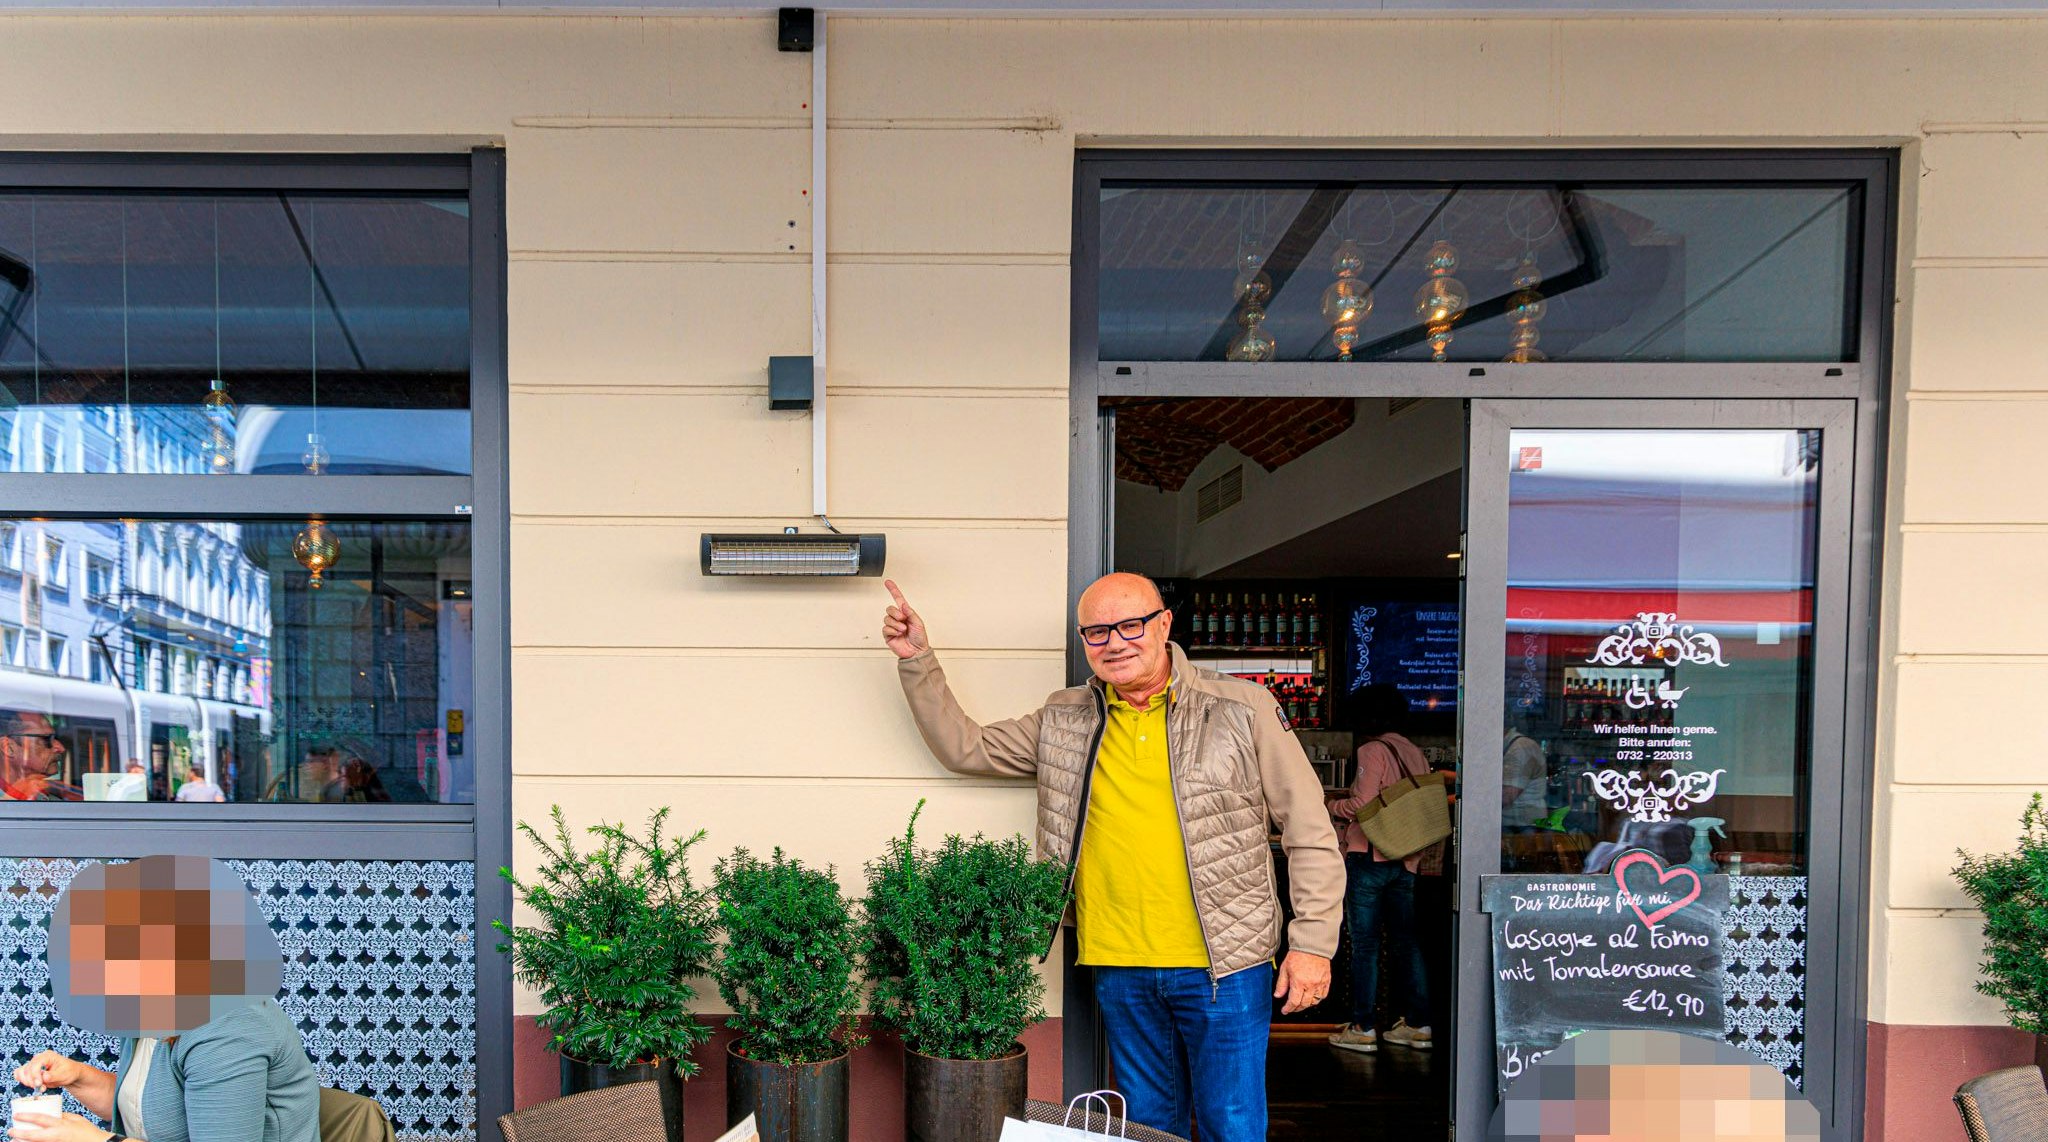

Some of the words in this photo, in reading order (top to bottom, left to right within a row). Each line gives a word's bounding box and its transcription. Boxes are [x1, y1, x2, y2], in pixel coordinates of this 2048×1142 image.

[1593, 724, 1613, 735] Wir
[1614, 724, 1647, 735] helfen
[1650, 724, 1680, 735] Ihnen
[1683, 726, 1717, 736] gerne.
[1619, 737, 1644, 747] Bitte
[1647, 737, 1691, 747] anrufen:
[1617, 750, 1643, 760] 0732
[1653, 750, 1693, 760] 220313
[1527, 883, 1597, 892] GASTRONOMIE
[1511, 895, 1543, 912] Das
[1548, 892, 1611, 914] Richtige
[1609, 924, 1639, 948] al
[1499, 958, 1535, 982] mit
[1543, 954, 1697, 982] Tomatensauce
[1622, 990, 1705, 1017] €12,90
